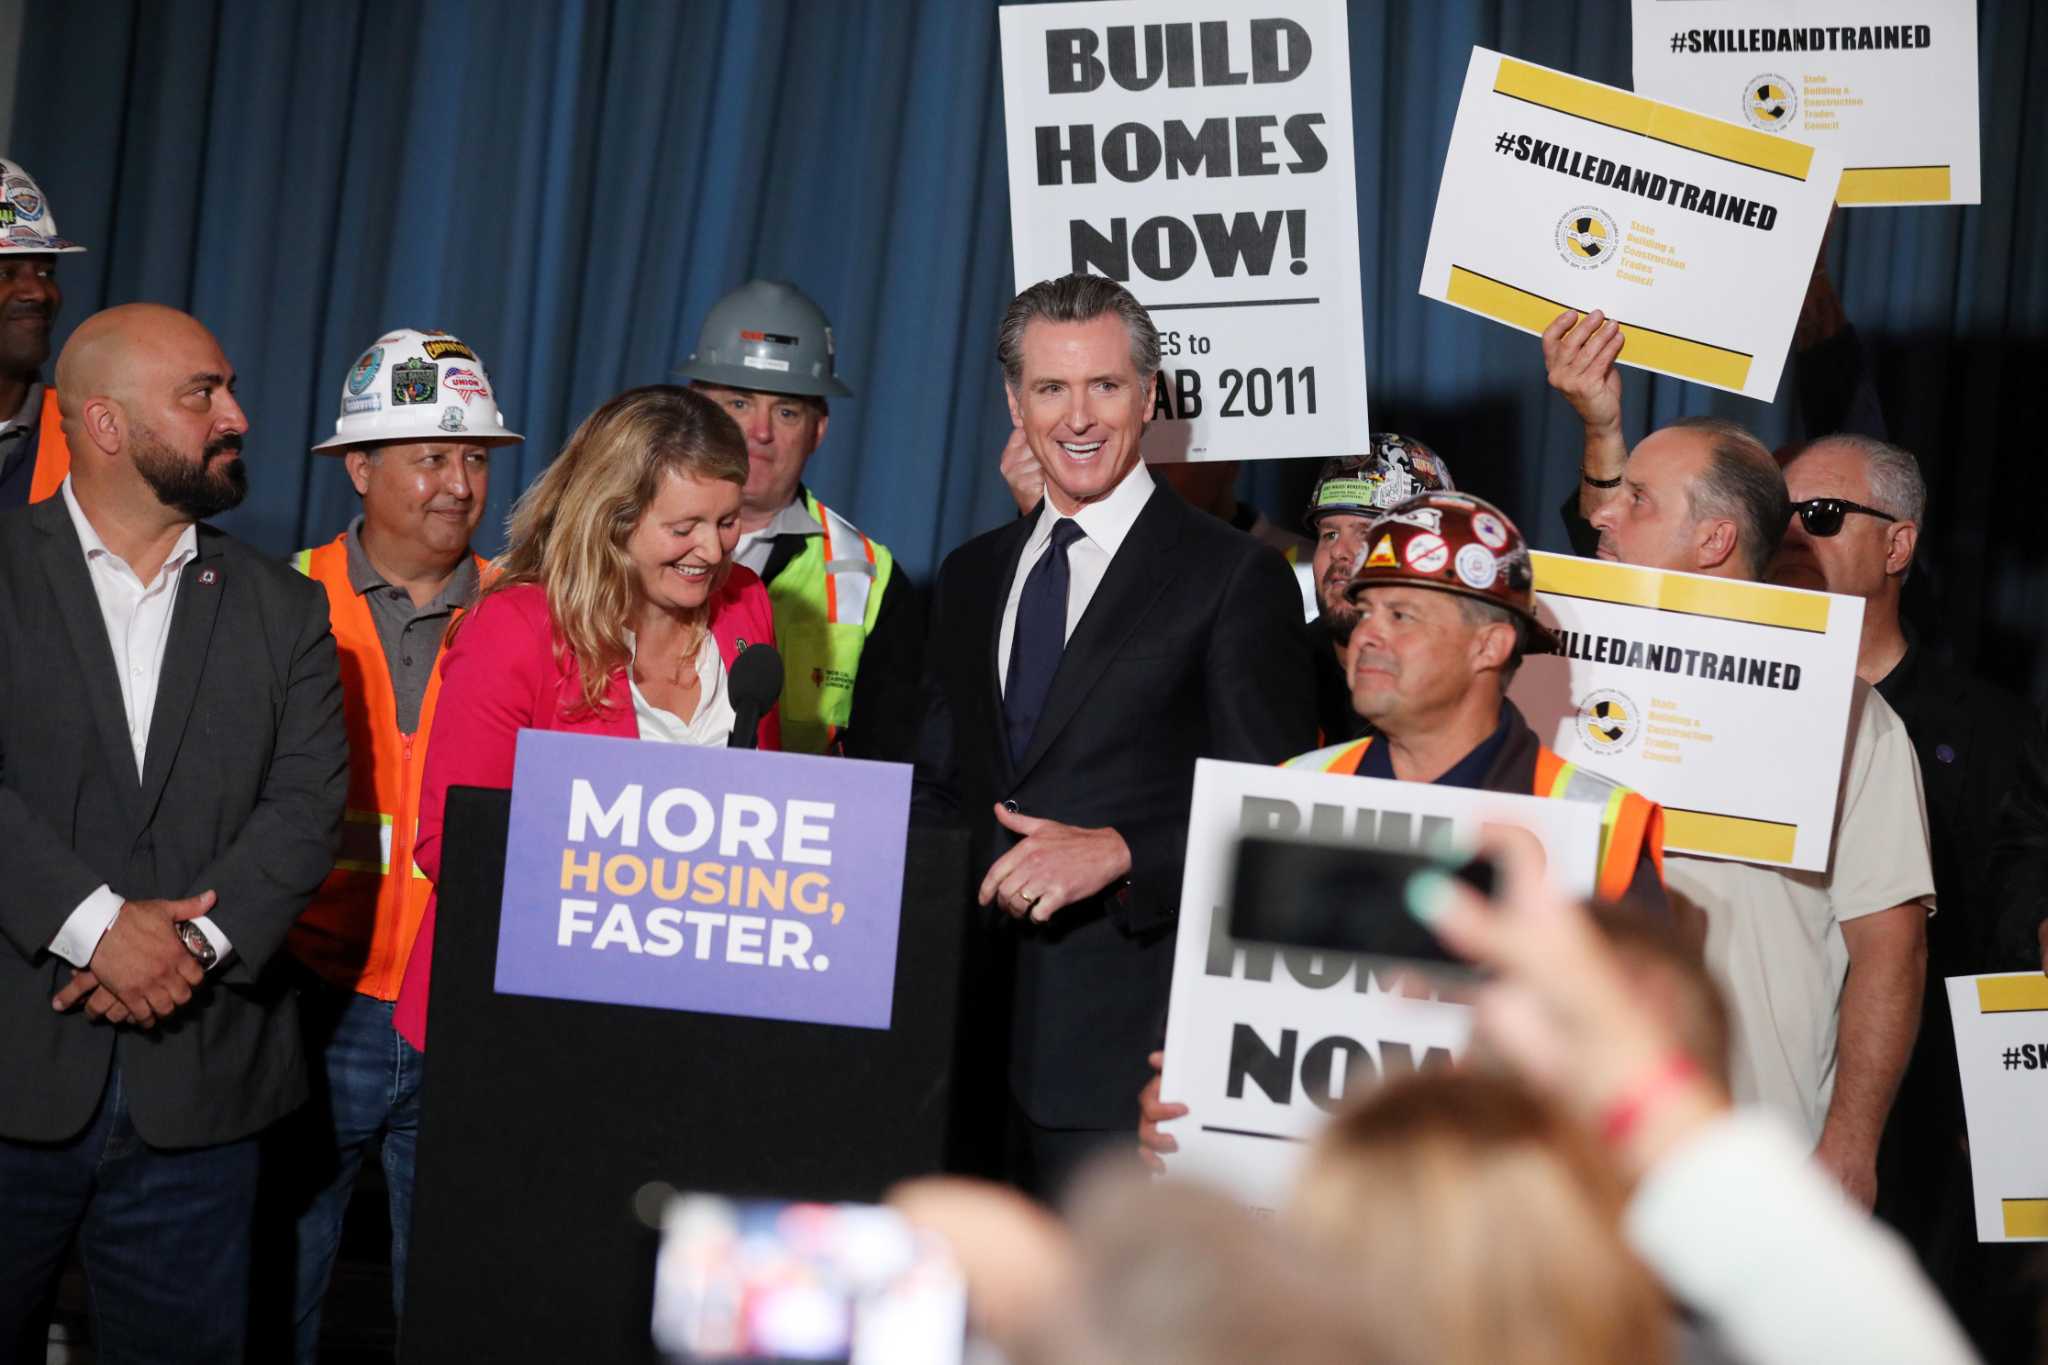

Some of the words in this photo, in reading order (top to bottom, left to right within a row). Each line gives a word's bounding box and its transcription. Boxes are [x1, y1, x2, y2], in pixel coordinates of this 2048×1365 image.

[1046, 18, 1312, 94] BUILD
[1670, 25, 1931, 53] #SKILLEDANDTRAINED
[1035, 113, 1328, 186] HOMES
[1494, 132, 1779, 231] #SKILLEDANDTRAINED
[1069, 209, 1308, 282] NOW!
[1623, 245, 1686, 270] Construction
[1631, 220, 1656, 236] State
[1188, 334, 1211, 355] to
[1151, 369, 1203, 420] AB
[1219, 366, 1317, 418] 2011
[567, 779, 836, 866] MORE
[560, 849, 846, 925] HOUSING,
[557, 898, 830, 972] FASTER.
